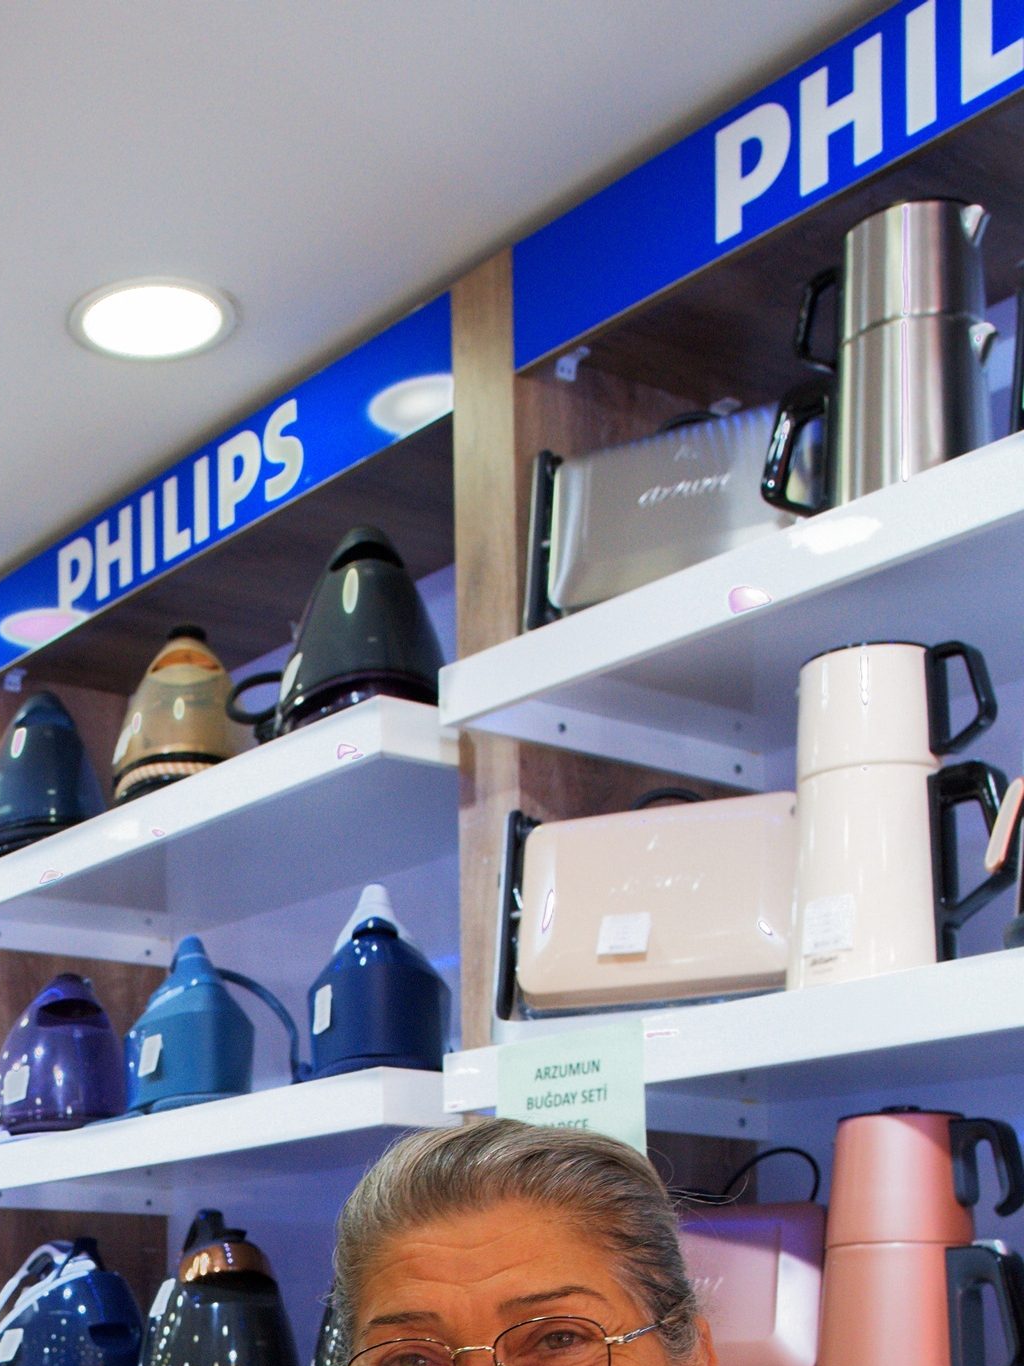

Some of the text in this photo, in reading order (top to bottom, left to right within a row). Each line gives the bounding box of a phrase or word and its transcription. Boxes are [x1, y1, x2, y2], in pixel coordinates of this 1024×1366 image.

[714, 0, 1024, 245] PHIL
[57, 397, 305, 611] PHILIPS
[526, 1083, 608, 1110] BUĞDAY SETİ
[534, 1060, 601, 1080] ARZUMUN
